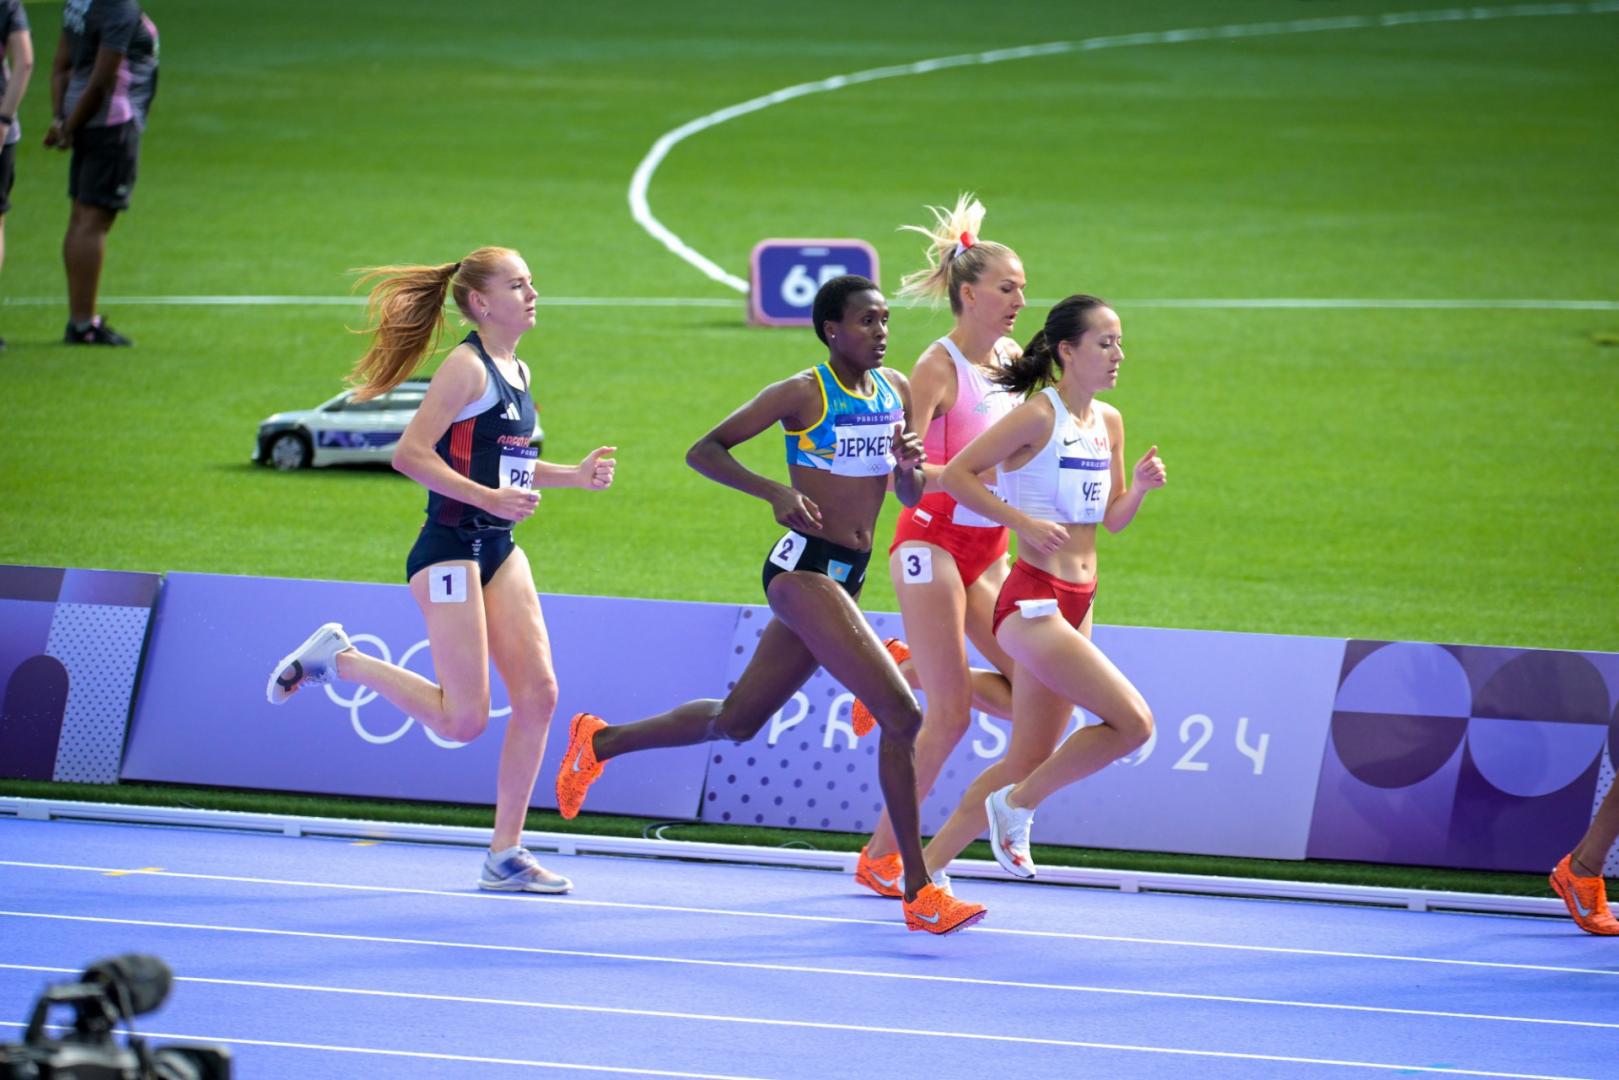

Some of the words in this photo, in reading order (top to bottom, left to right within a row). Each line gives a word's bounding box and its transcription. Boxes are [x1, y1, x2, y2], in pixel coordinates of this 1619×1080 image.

[777, 539, 794, 561] 2
[907, 554, 922, 577] 3
[442, 574, 452, 595] 1
[766, 690, 1008, 759] PAS
